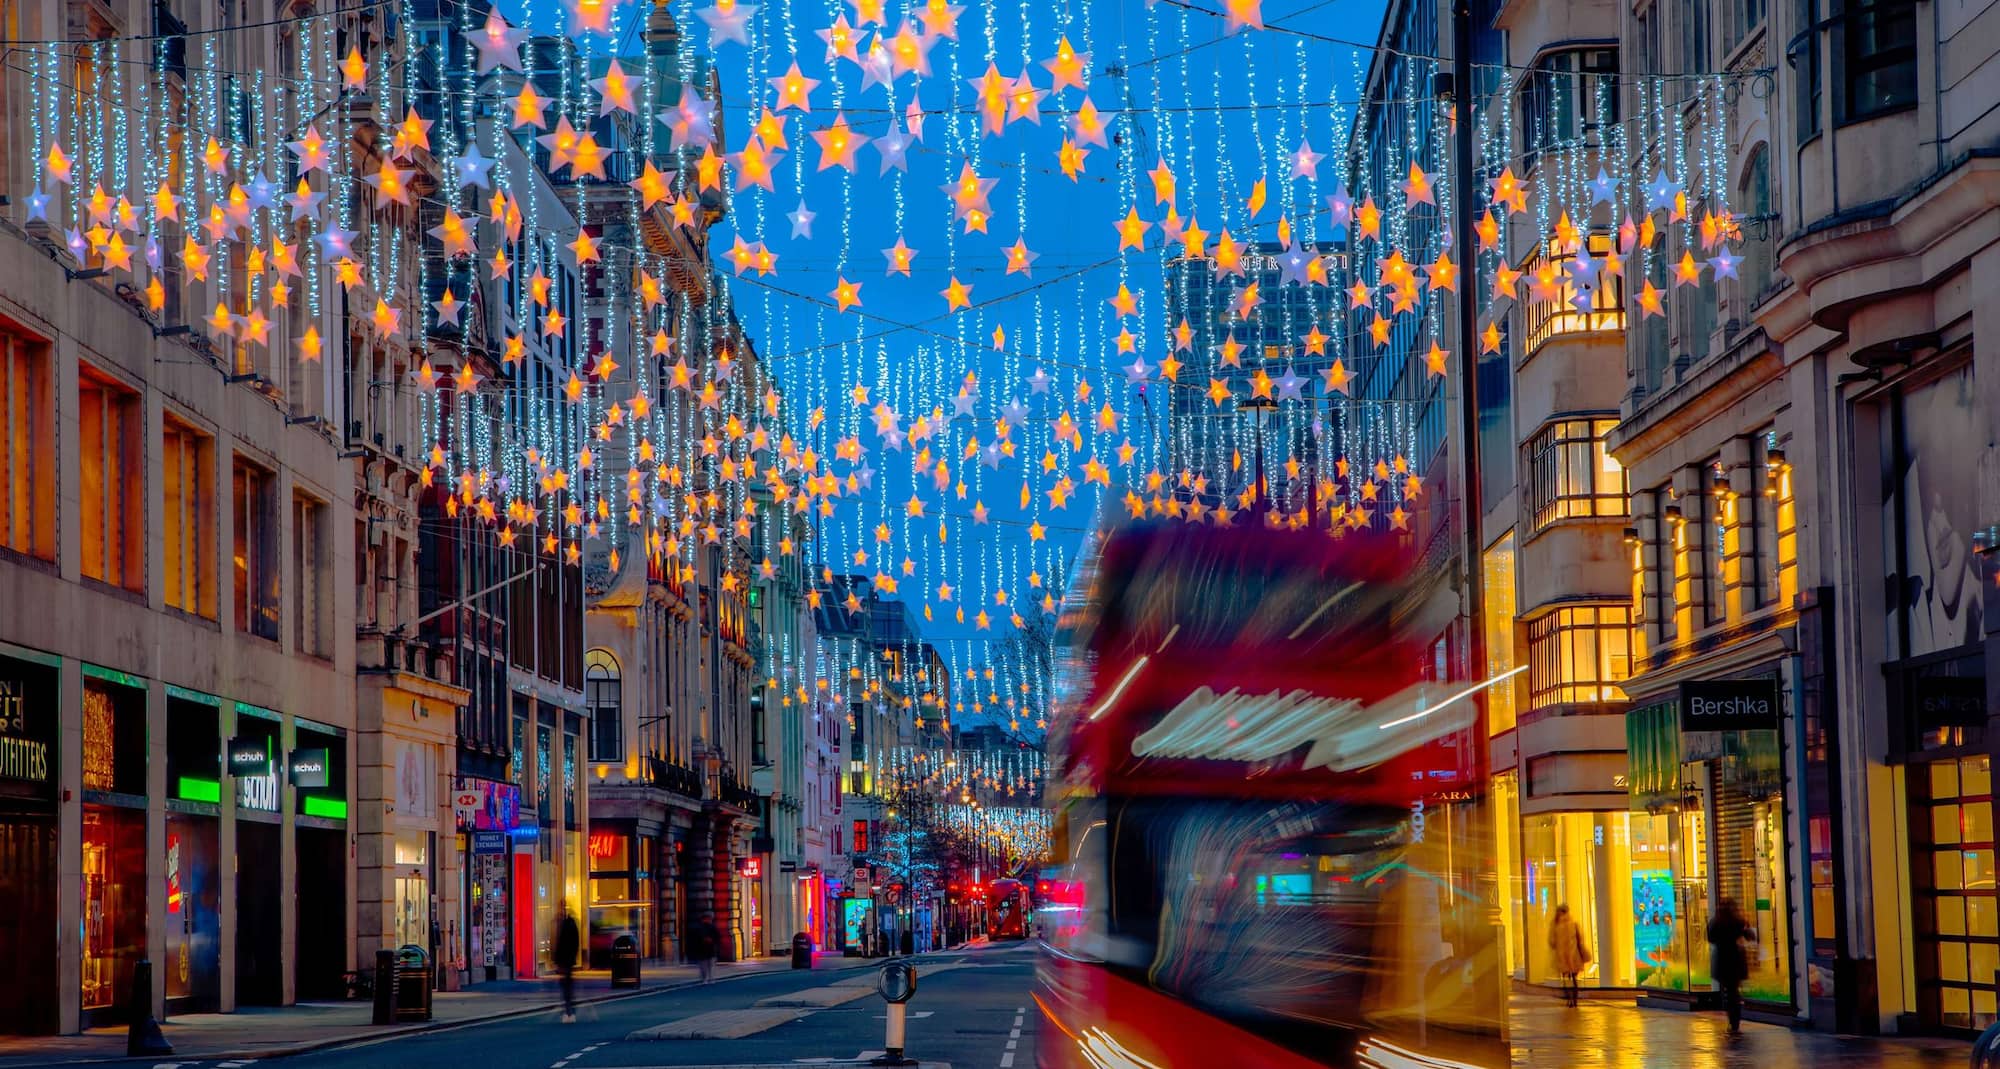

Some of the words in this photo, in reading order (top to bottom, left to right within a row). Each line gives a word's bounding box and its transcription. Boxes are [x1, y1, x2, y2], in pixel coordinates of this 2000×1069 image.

[1691, 696, 1768, 715] Bershka
[234, 752, 264, 762] schuh
[294, 763, 321, 772] schuh
[485, 854, 493, 884] NEY
[485, 893, 493, 963] EXCHANGE
